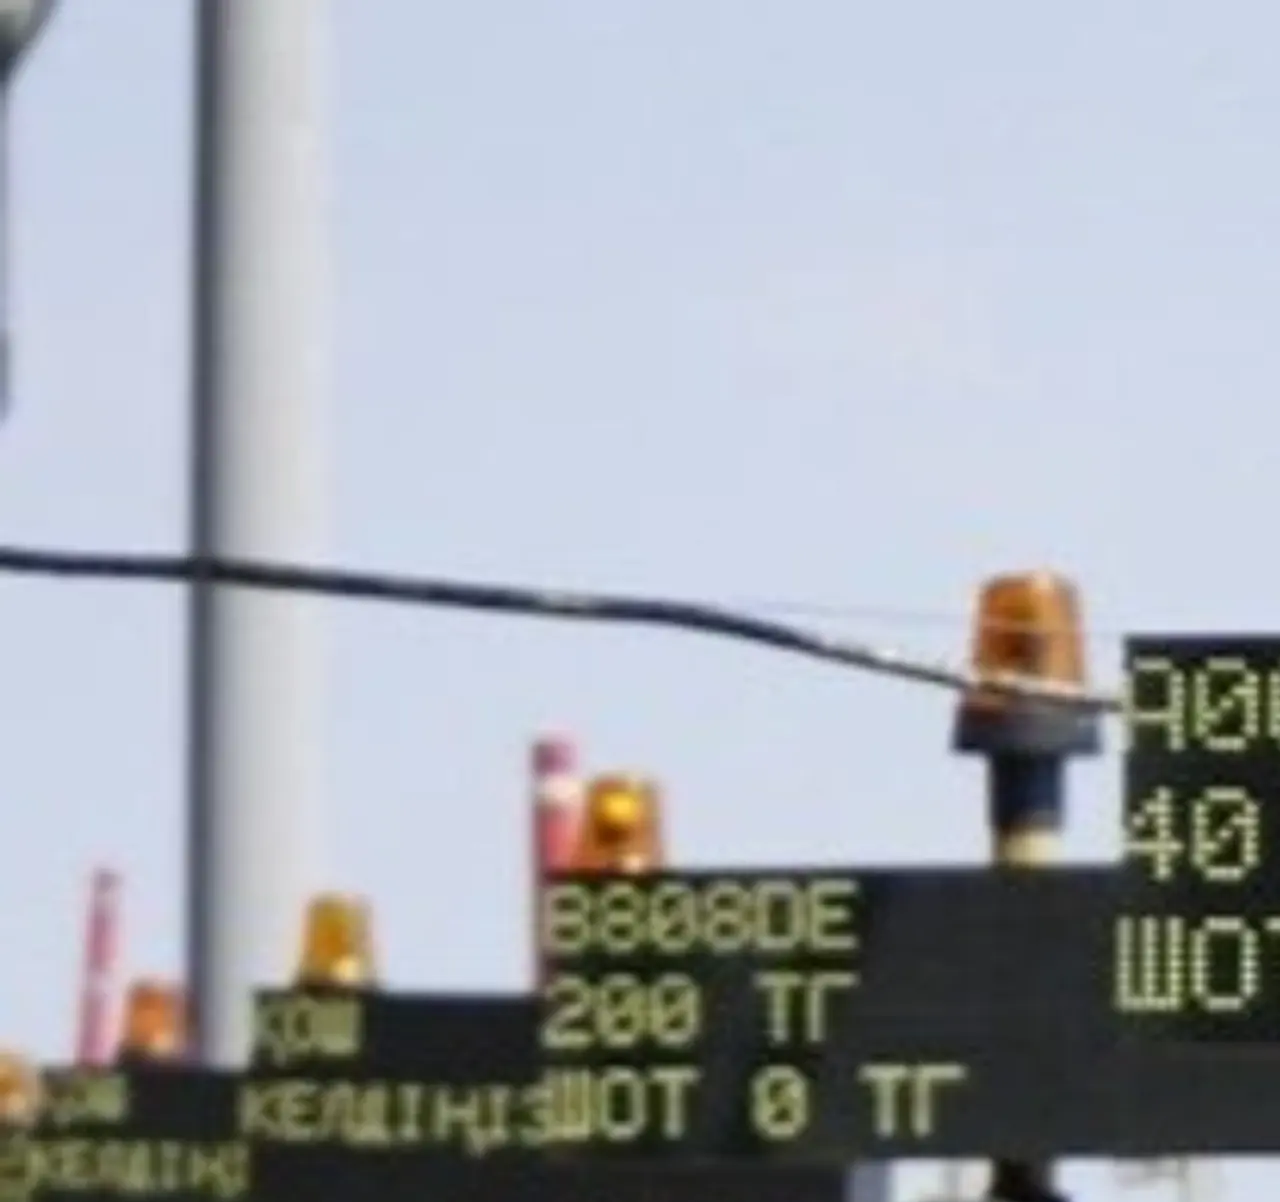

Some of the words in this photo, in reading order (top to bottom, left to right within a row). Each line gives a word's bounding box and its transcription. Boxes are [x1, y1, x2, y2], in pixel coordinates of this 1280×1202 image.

[1123, 785, 1260, 882] 40
[540, 972, 700, 1048] 200
[750, 1064, 806, 1141] 0
